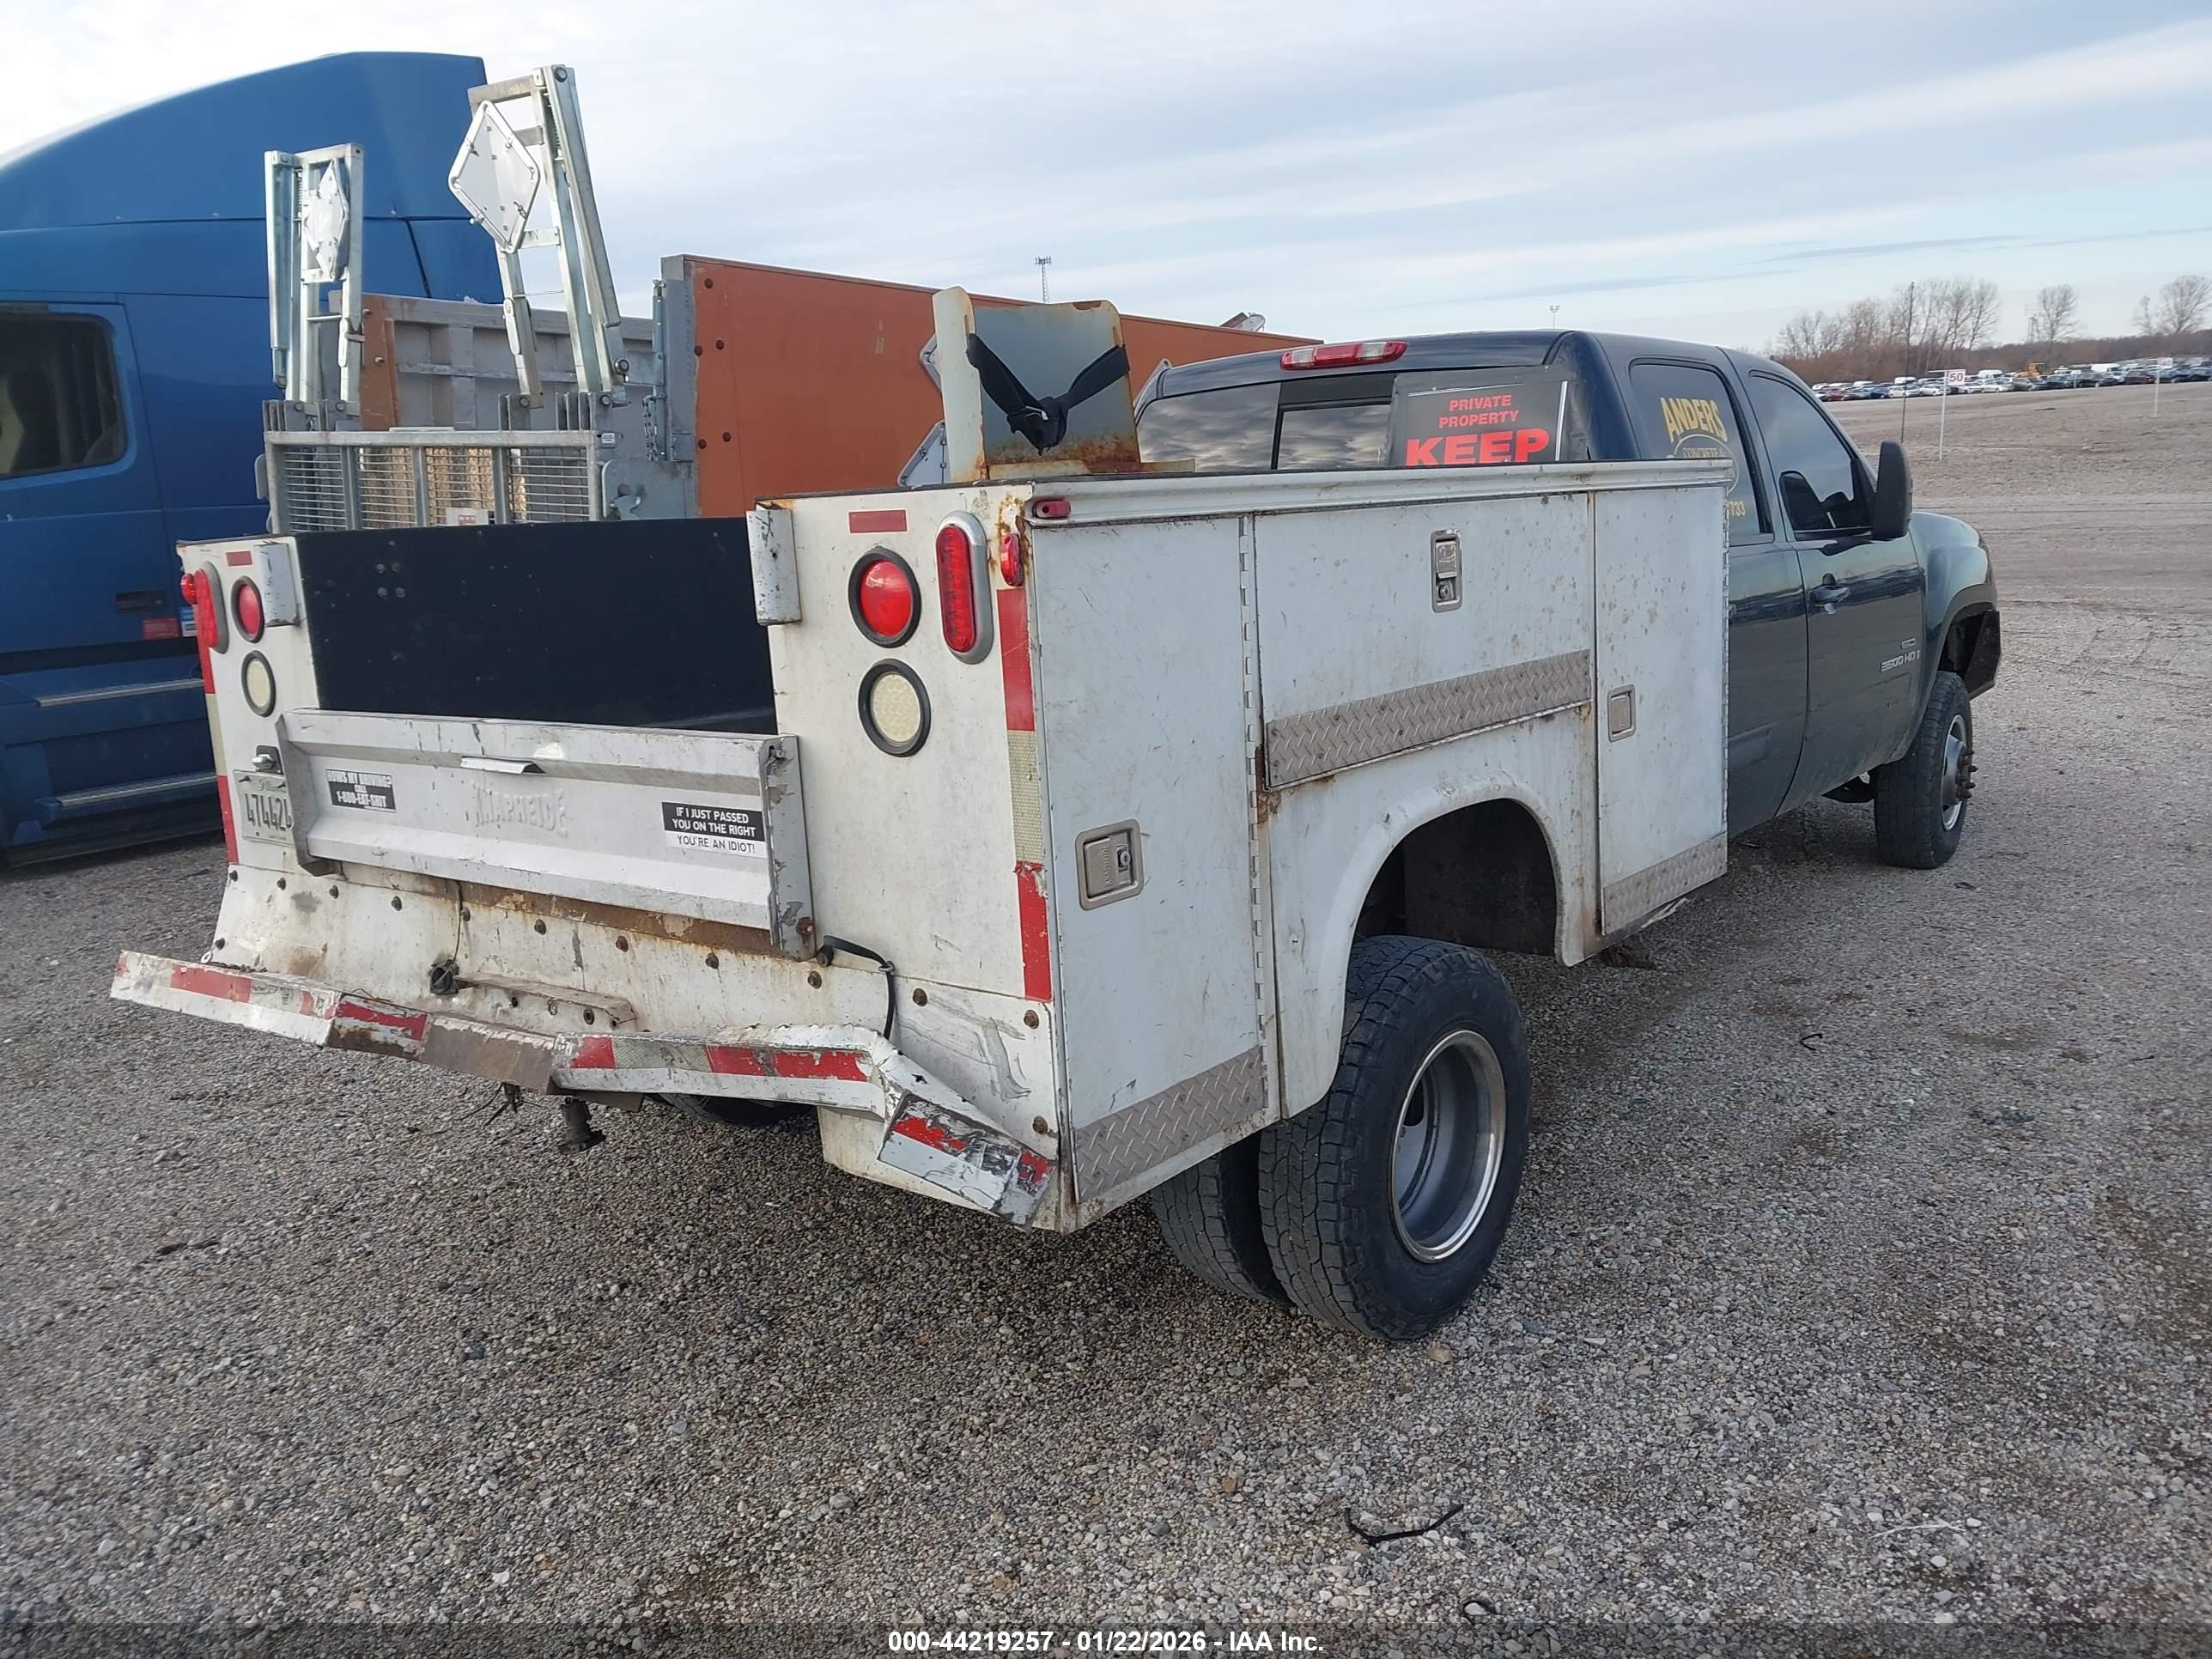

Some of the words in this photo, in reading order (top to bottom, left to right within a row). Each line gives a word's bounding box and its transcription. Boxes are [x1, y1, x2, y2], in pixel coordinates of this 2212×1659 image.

[1950, 372, 1964, 382] 50
[1449, 394, 1512, 411] PRIVATE
[1438, 410, 1519, 428] PROPERTY
[1660, 398, 1728, 444] ANDERS
[1406, 428, 1550, 466] KEEP
[676, 807, 684, 817] IF
[690, 809, 712, 820] JUST
[714, 811, 749, 823] PASSED
[672, 818, 691, 830] YOU
[693, 821, 707, 831] ON
[708, 823, 726, 834] THE
[729, 824, 756, 837] RIGHT
[677, 835, 710, 848] YOU'RE
[713, 839, 726, 849] AN
[728, 841, 756, 854] IDIOT!
